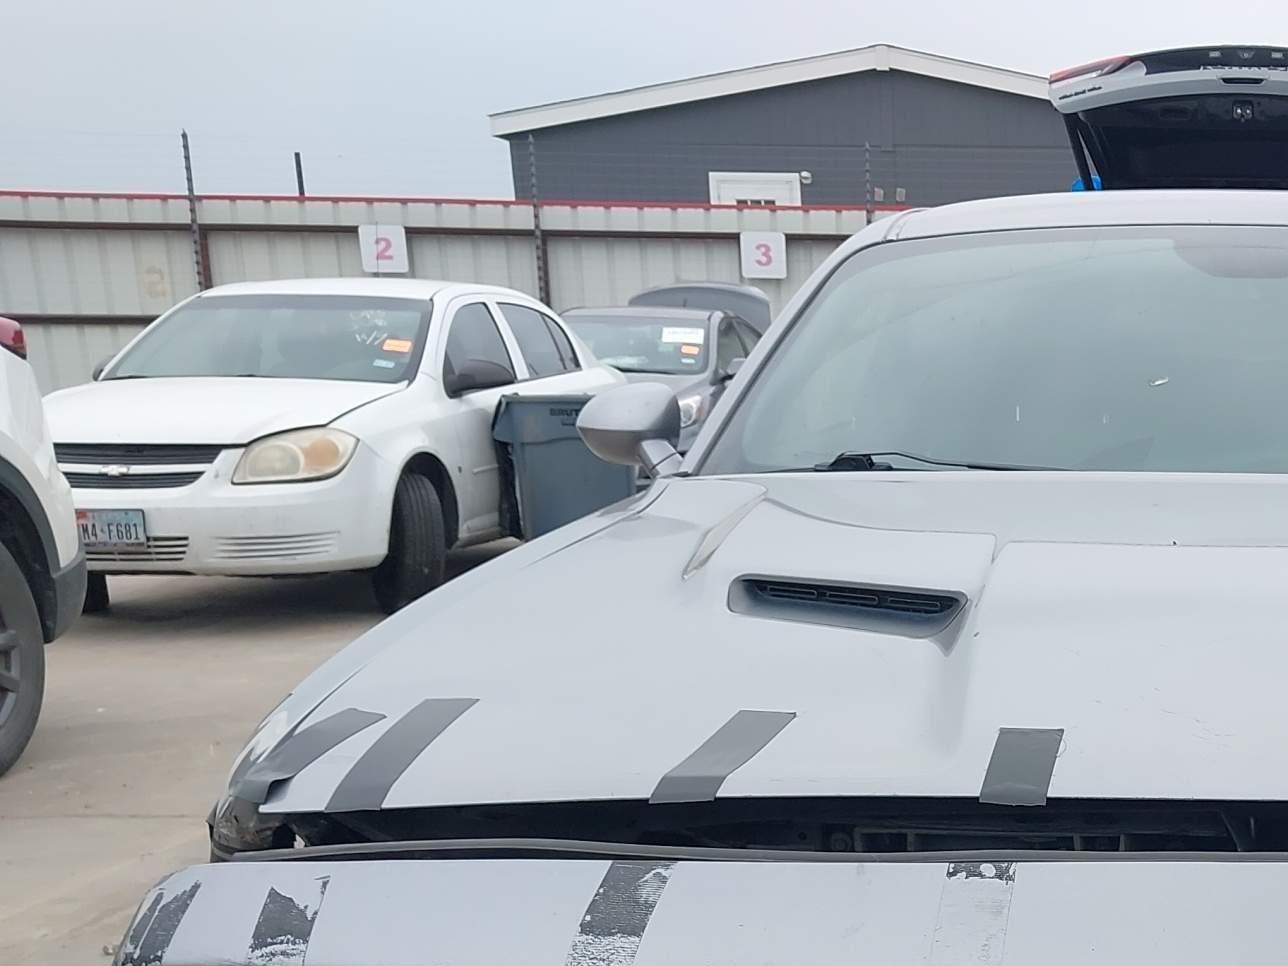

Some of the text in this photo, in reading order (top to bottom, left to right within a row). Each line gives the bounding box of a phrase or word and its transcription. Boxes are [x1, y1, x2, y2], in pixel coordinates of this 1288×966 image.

[374, 238, 394, 261] 2
[754, 243, 773, 267] 3
[77, 522, 98, 541] M4
